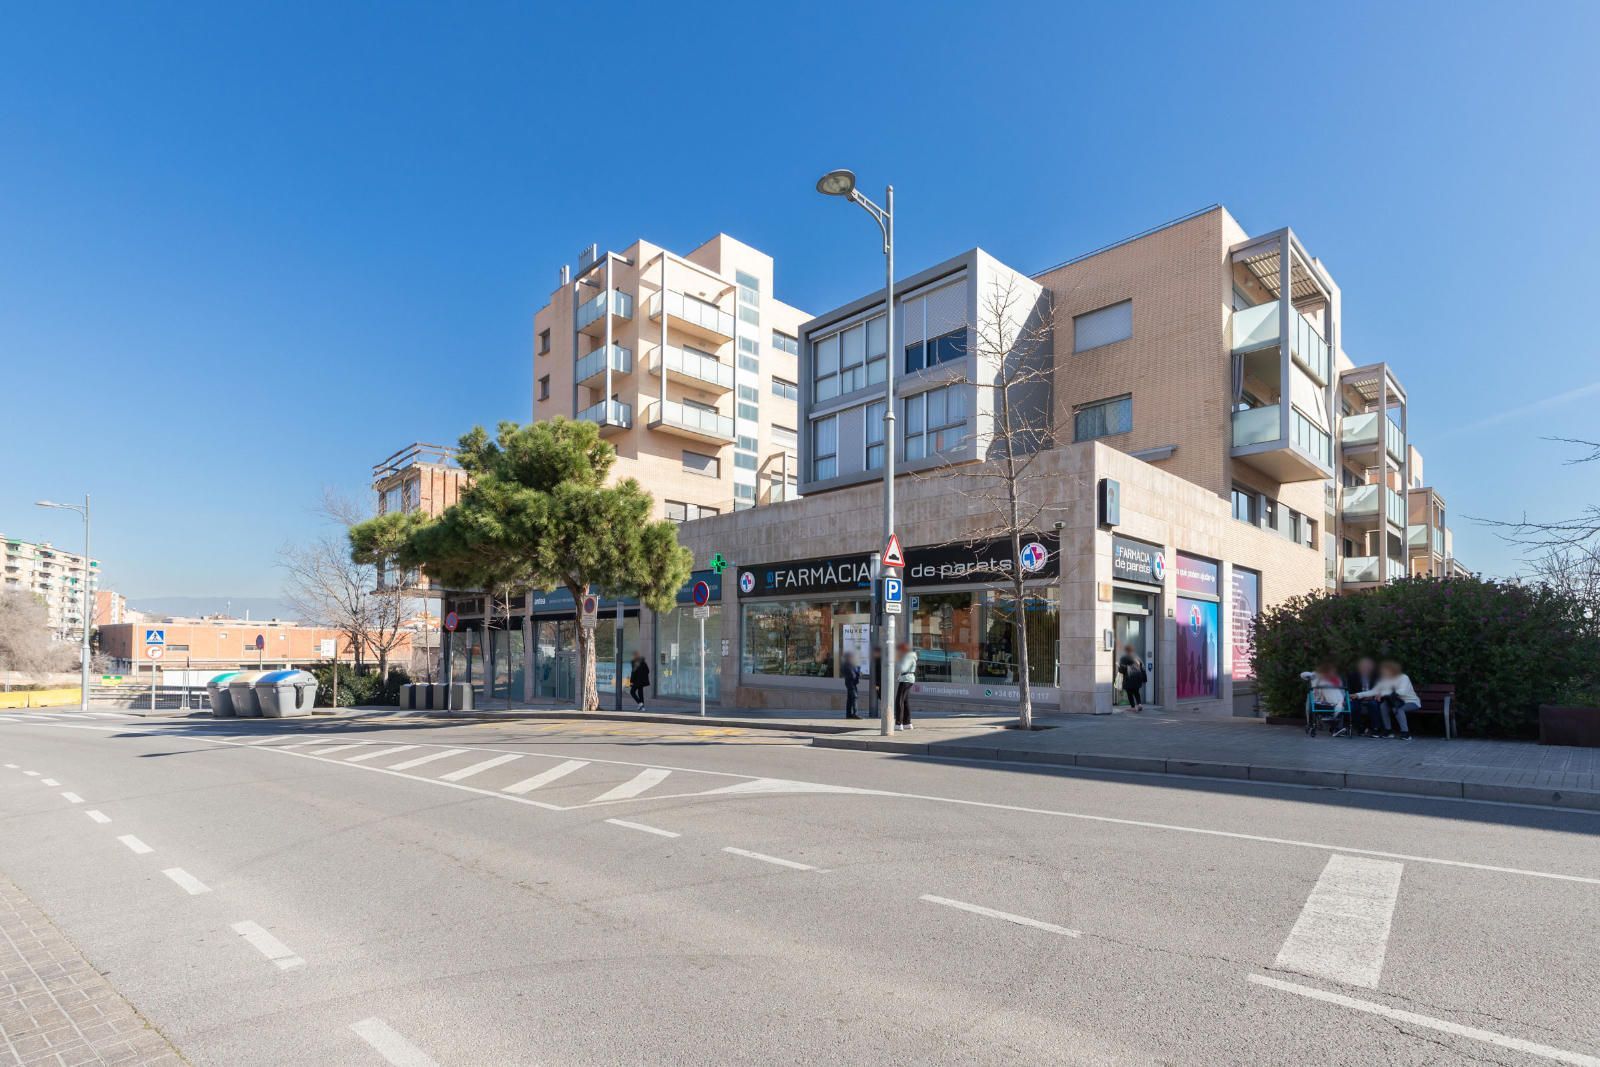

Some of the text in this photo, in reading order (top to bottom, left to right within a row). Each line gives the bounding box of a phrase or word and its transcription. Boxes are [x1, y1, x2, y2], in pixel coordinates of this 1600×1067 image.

[774, 560, 871, 588] FARMÀCIA
[910, 562, 936, 578] de
[940, 556, 1013, 580] parets
[1114, 556, 1126, 569] de
[888, 580, 899, 600] P
